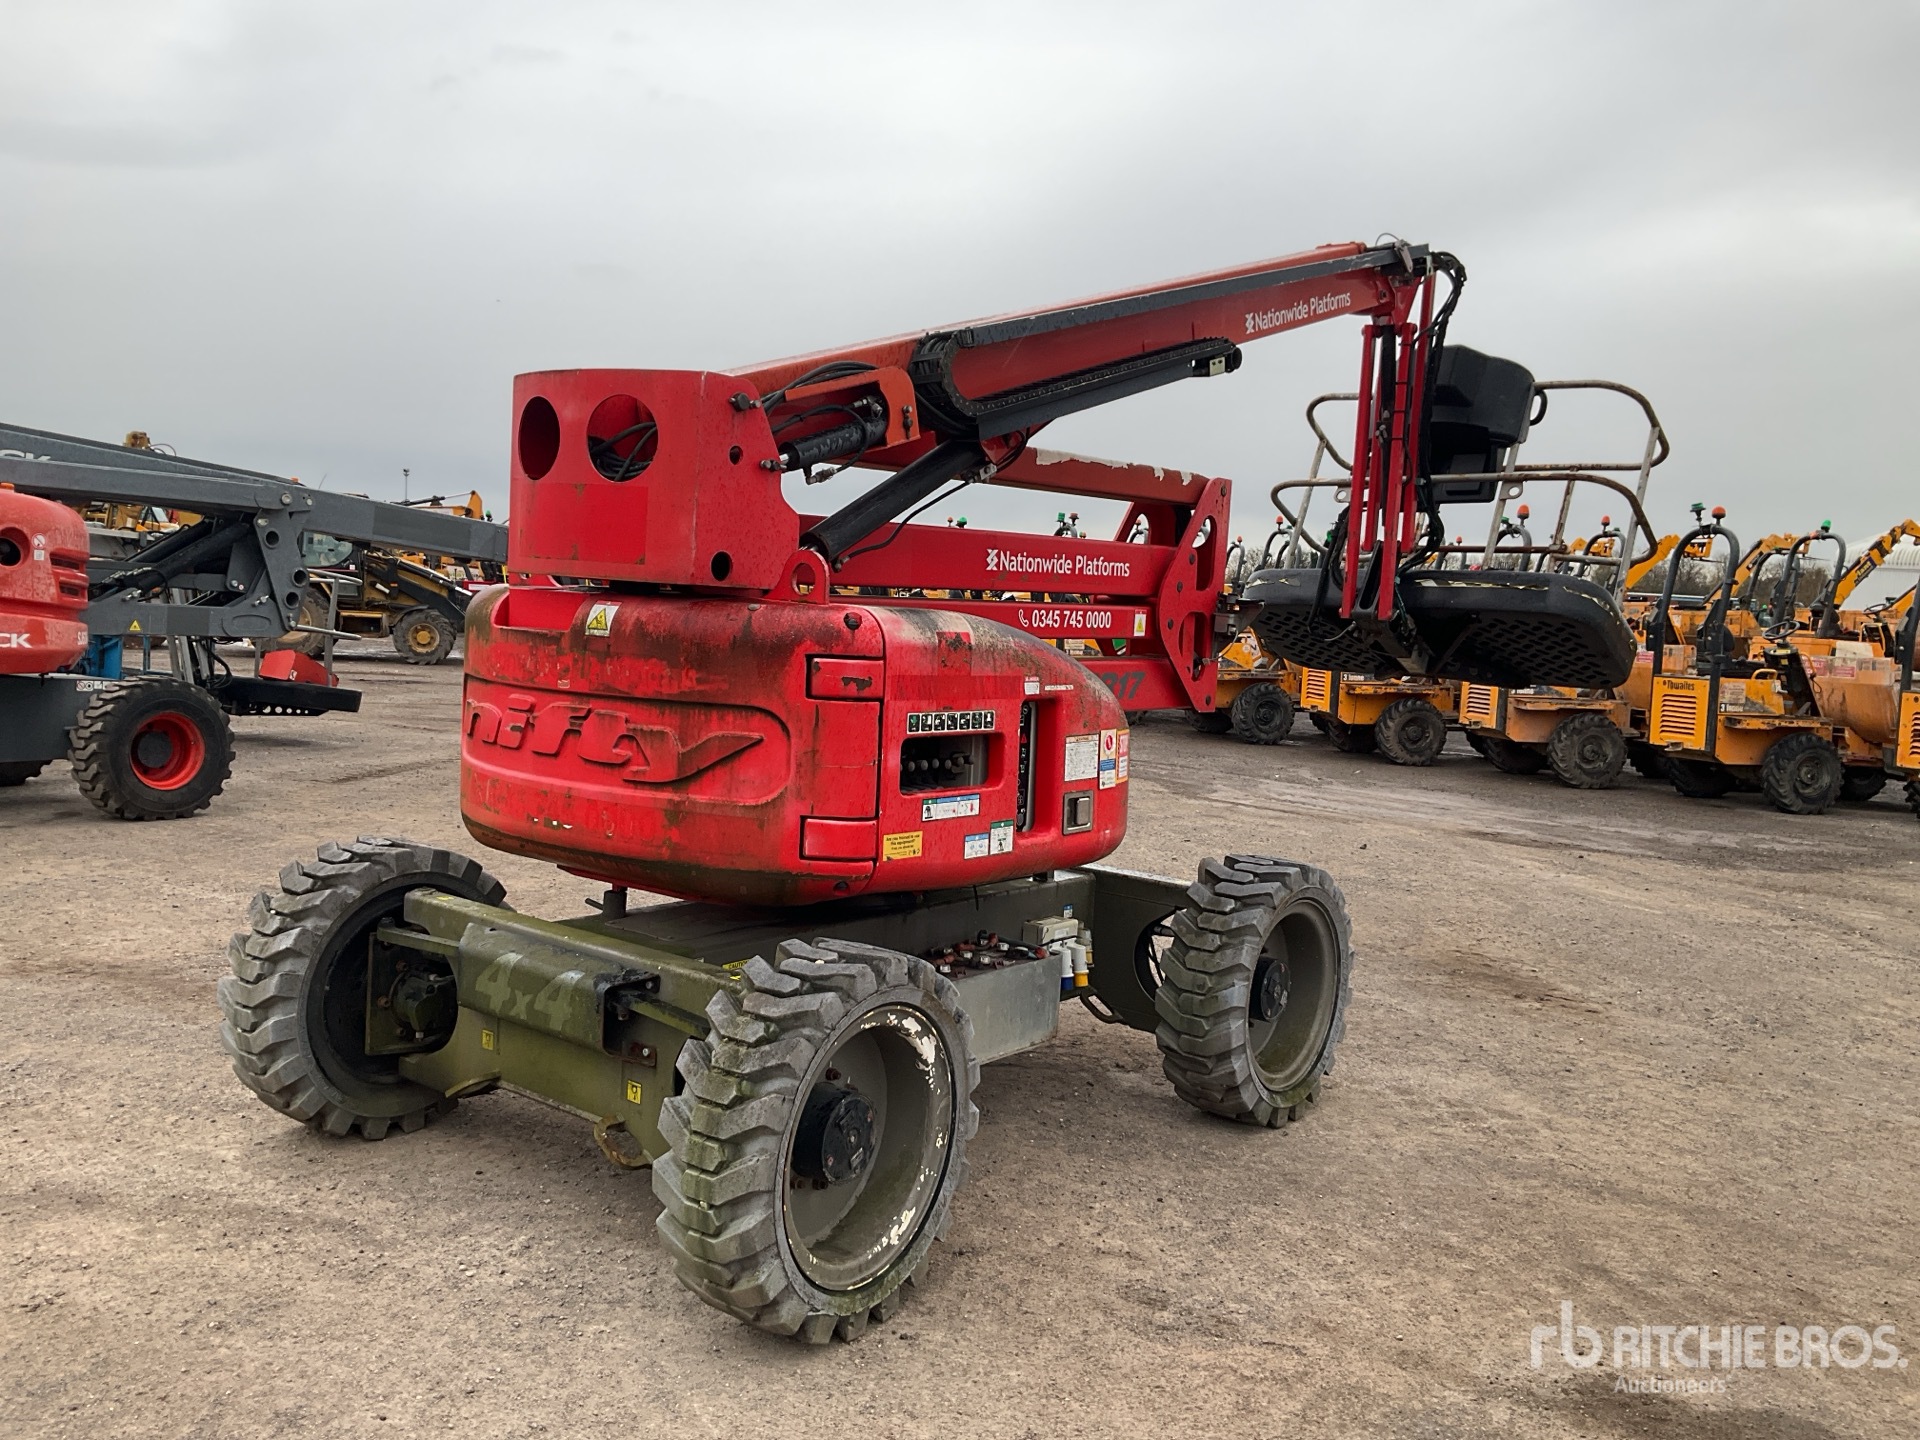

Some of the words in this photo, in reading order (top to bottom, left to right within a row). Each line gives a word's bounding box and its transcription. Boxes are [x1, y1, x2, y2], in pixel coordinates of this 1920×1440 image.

[1255, 300, 1308, 332] Nationwide
[1310, 292, 1351, 316] Platforms
[1000, 550, 1072, 574] Nationwide
[1075, 554, 1131, 578] Platforms
[1031, 609, 1060, 629] 0345
[1063, 609, 1084, 629] 745
[1086, 610, 1112, 628] 0000
[1667, 679, 1695, 691] Thwaites
[1720, 703, 1725, 712] 3
[466, 694, 764, 782] nifty
[475, 951, 586, 1032] 4x4
